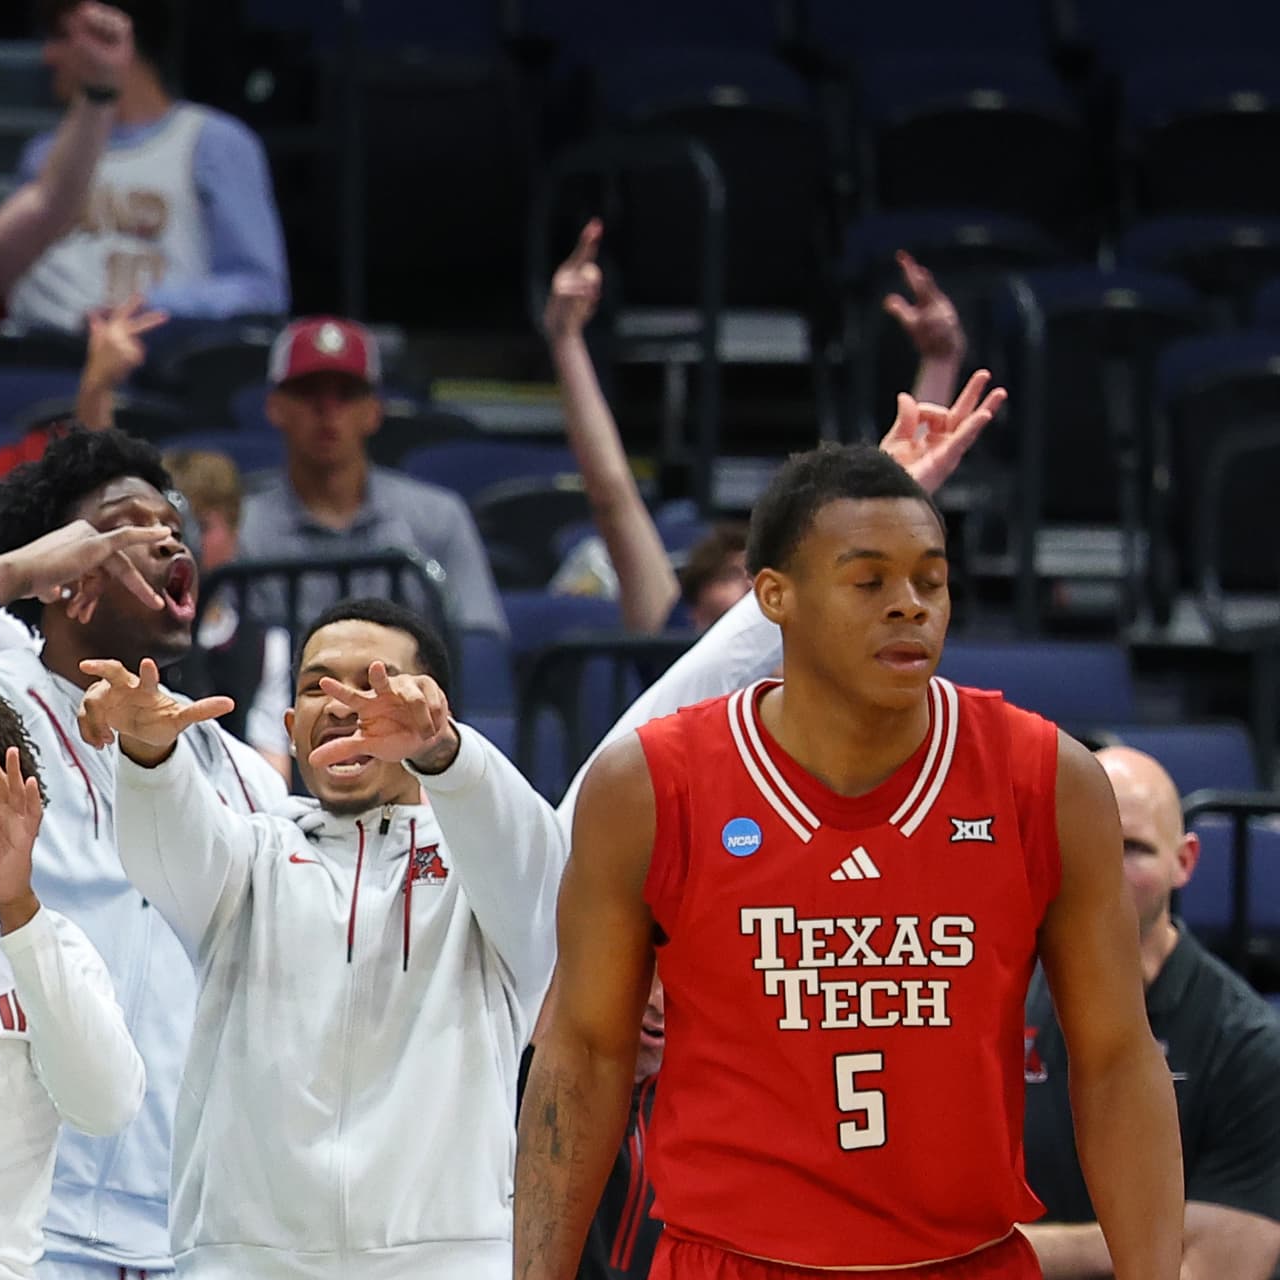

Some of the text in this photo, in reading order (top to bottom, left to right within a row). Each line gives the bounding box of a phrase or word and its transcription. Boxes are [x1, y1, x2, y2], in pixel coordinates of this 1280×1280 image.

[726, 834, 761, 848] NCAA
[949, 817, 996, 842] XII
[739, 905, 977, 970] TEXAS
[763, 966, 952, 1031] TECH
[833, 1050, 888, 1151] 5
